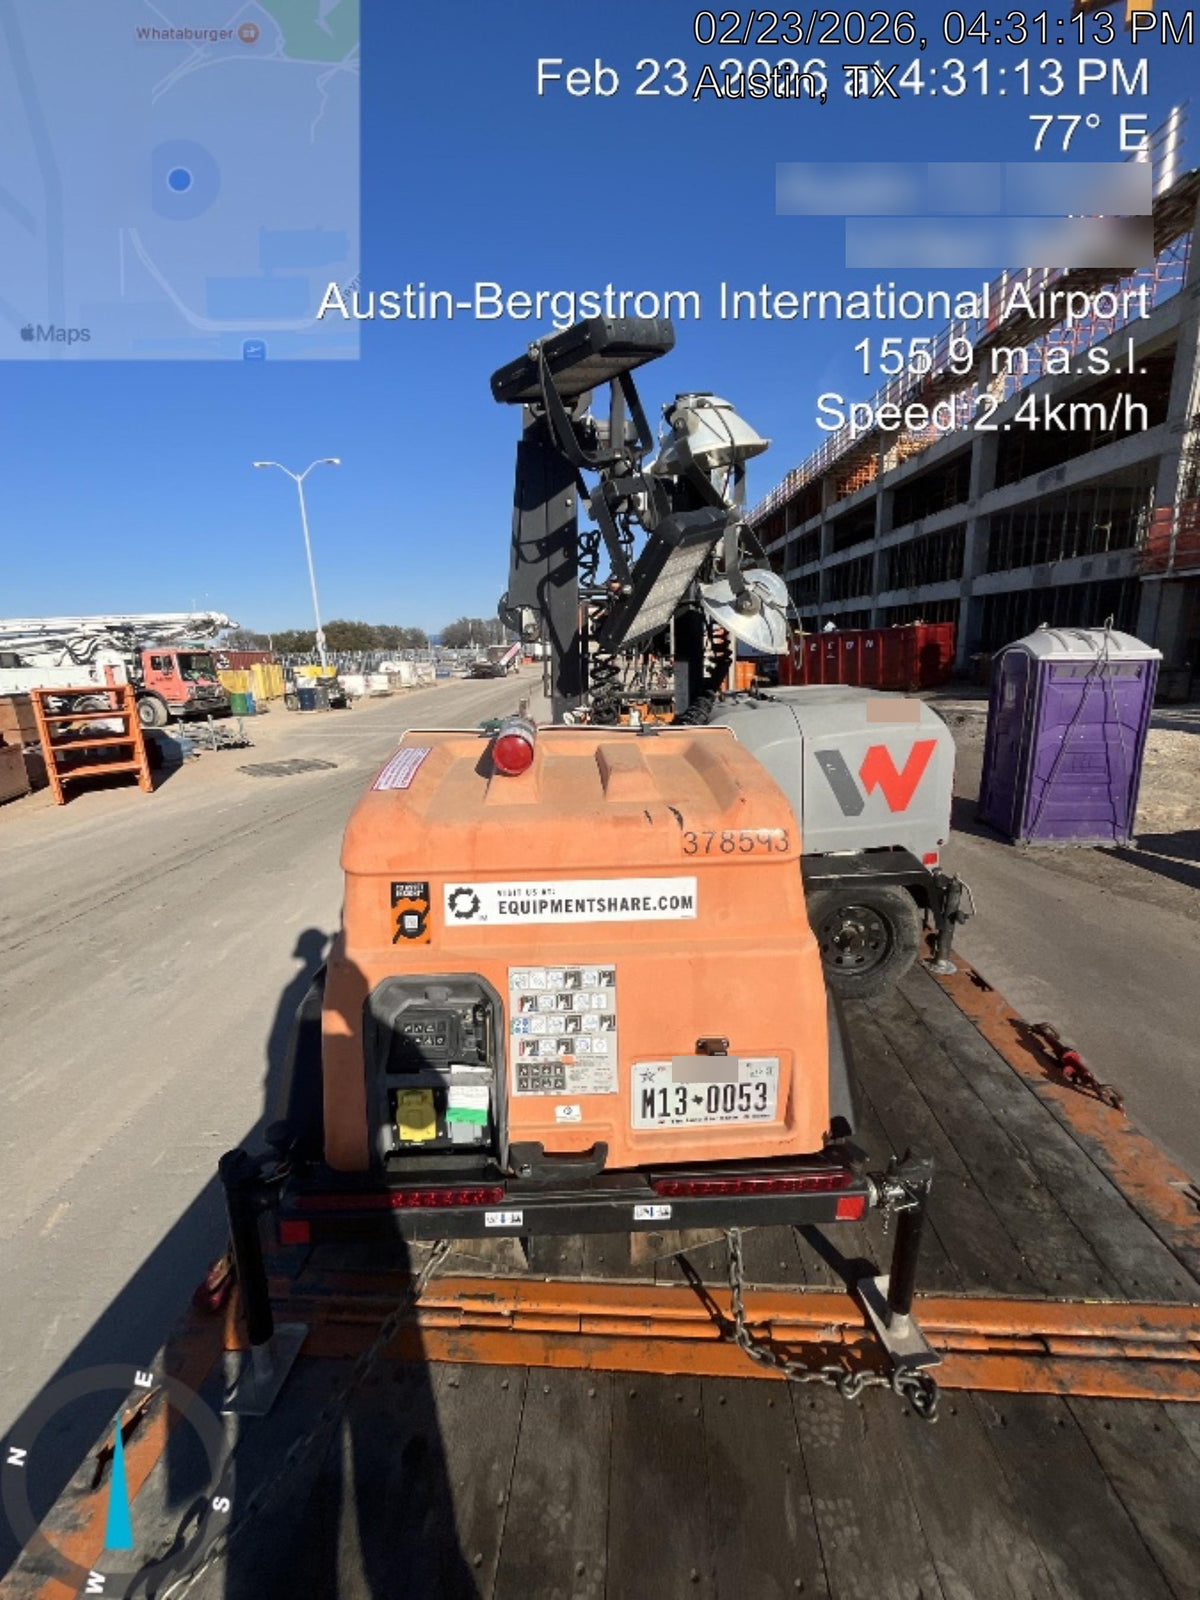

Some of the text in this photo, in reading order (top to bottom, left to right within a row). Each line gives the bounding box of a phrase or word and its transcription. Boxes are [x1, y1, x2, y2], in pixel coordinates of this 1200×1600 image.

[683, 829, 789, 855] 378593
[499, 896, 693, 916] EQUIPMENTSHARE.COM
[707, 1082, 767, 1114] 0053
